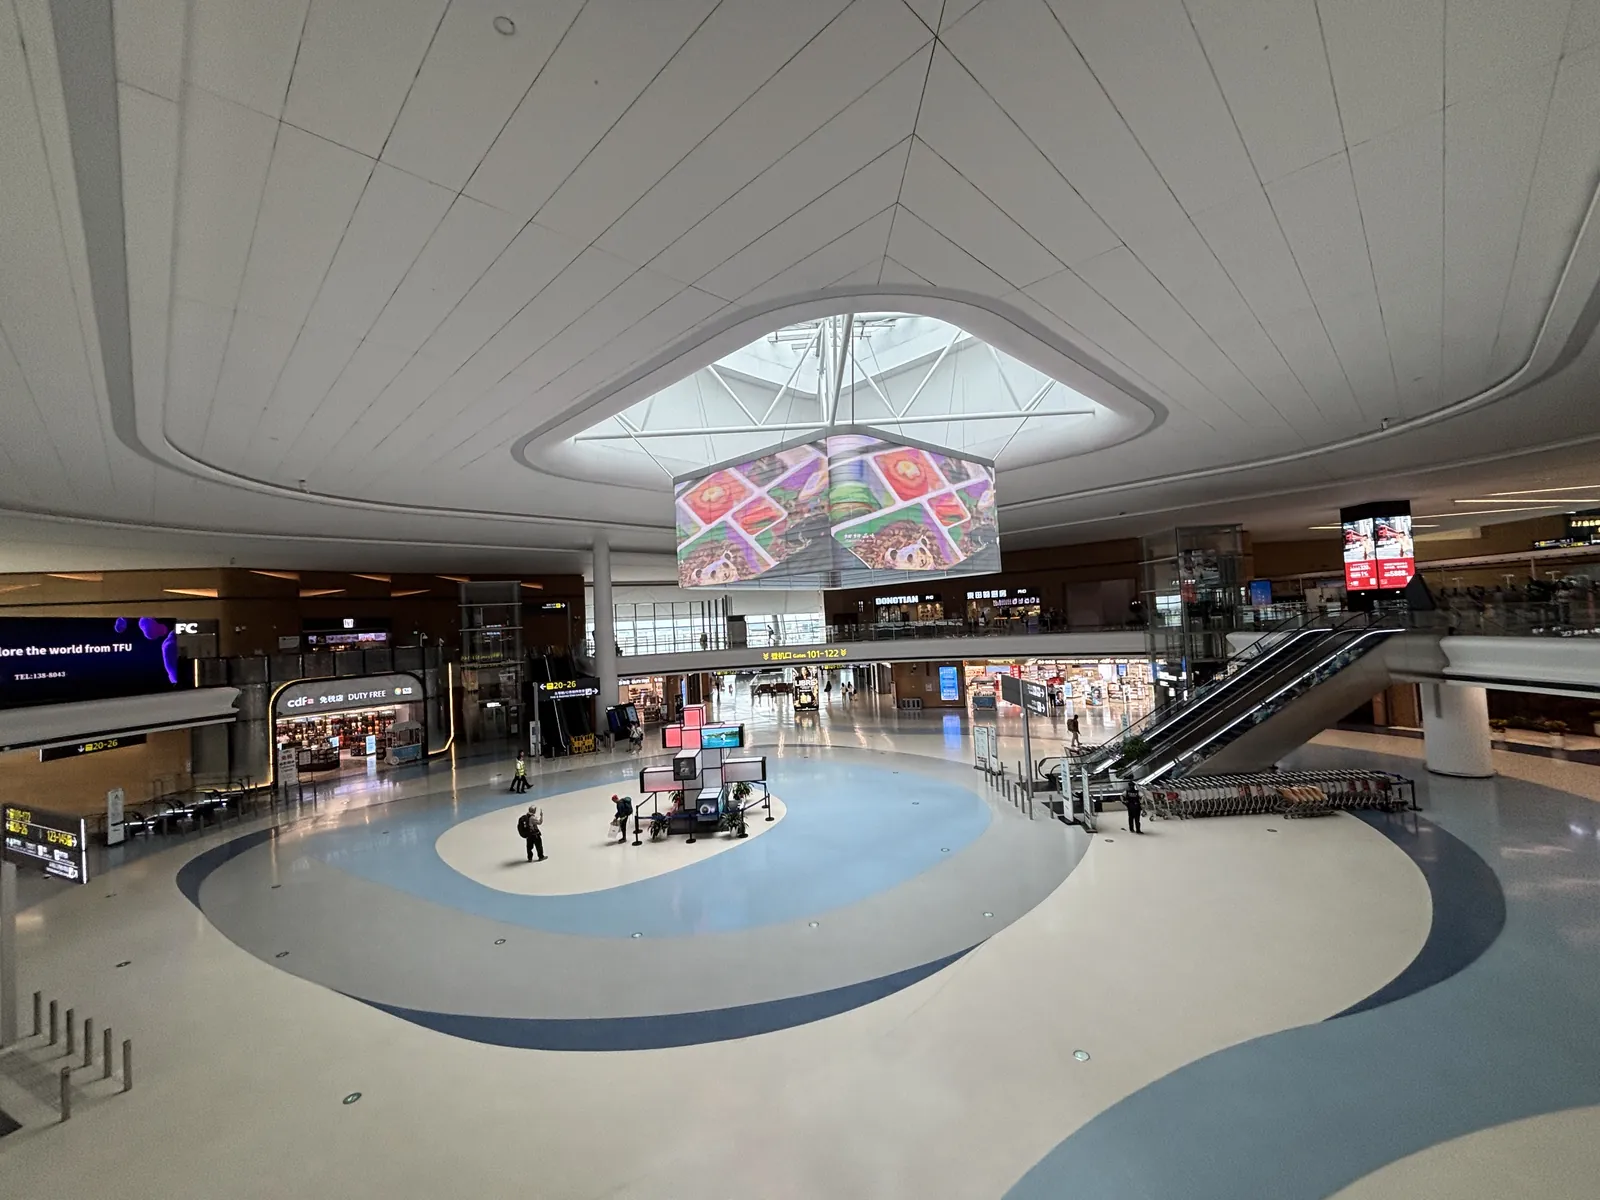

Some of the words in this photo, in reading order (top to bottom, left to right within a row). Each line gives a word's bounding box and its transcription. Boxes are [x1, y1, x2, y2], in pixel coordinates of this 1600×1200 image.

[25, 645, 47, 656] the
[49, 644, 82, 655] world
[84, 643, 111, 653] from
[113, 643, 133, 653] TFU
[806, 649, 839, 659] 101-122
[553, 680, 577, 689] 20-26
[287, 696, 308, 708] cdf
[348, 692, 369, 701] DUTY
[369, 690, 387, 699] FREE
[93, 739, 118, 750] 20-26
